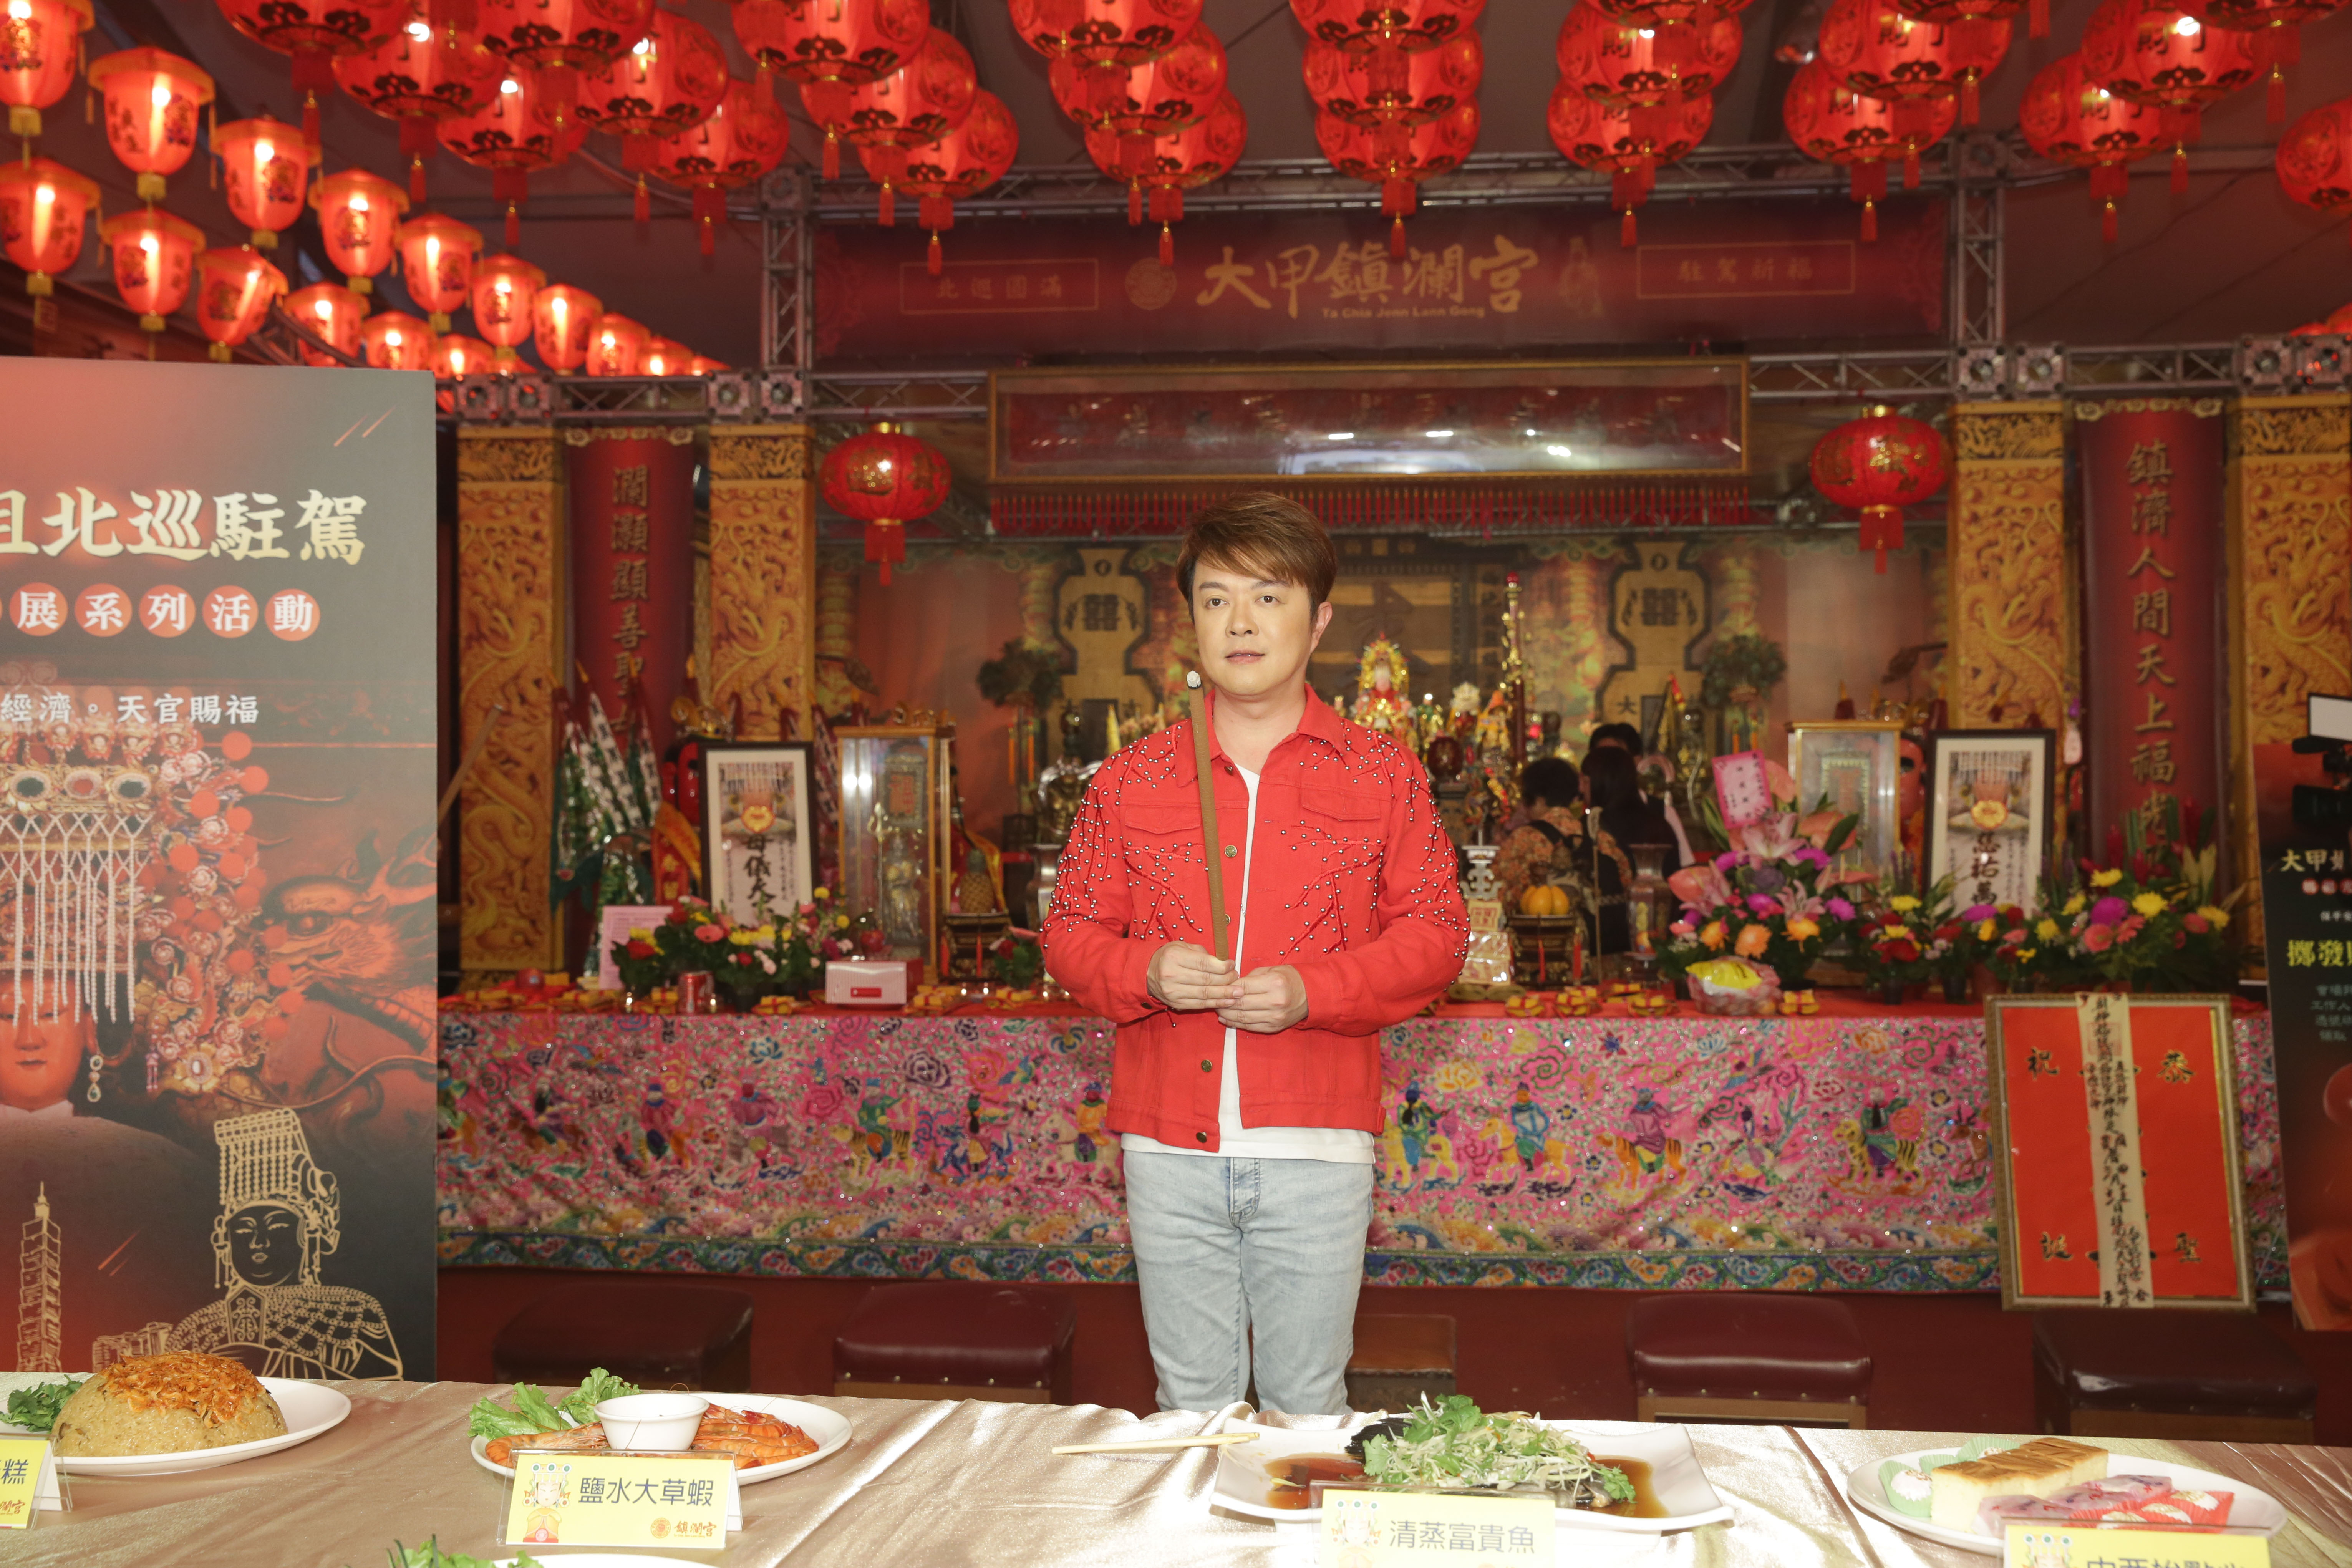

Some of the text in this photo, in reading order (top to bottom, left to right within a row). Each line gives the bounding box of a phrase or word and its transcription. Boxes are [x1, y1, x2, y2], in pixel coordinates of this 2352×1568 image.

[1196, 234, 1538, 318] 大甲鎮瀾宮
[1321, 308, 1338, 318] Ta
[17, 590, 314, 632] 展系列活動
[1, 1459, 29, 1484] 糕
[578, 1477, 714, 1506] 鹽水大草蝦
[674, 1521, 717, 1537] 鎮瀾宮
[1389, 1520, 1535, 1554] 清蒸富貴魚
